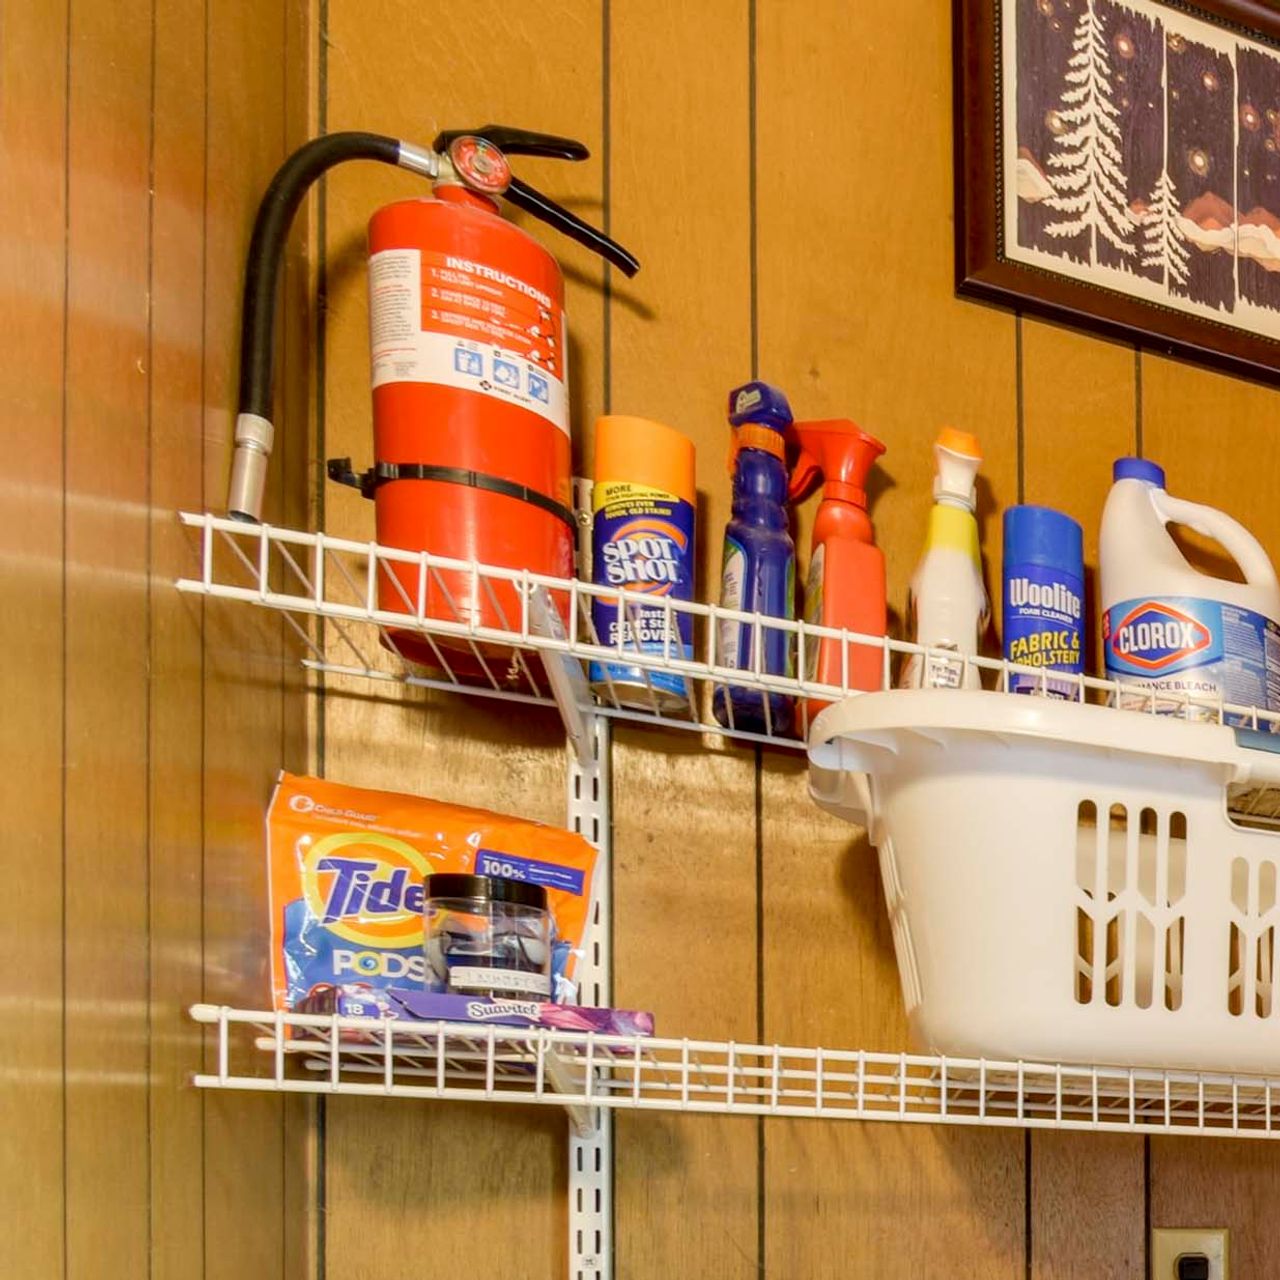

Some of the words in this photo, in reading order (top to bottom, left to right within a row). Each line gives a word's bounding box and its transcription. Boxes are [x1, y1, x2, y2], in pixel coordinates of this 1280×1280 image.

[445, 256, 552, 309] INSTRUCTIONS
[605, 484, 632, 497] MORE
[602, 538, 673, 563] SPOT
[607, 559, 679, 584] SHOT
[1010, 578, 1080, 619] Woolite
[1019, 607, 1041, 616] FOAM
[1042, 609, 1073, 624] CLEANER
[1010, 631, 1069, 660] FABRIC
[1071, 630, 1080, 649] &
[1119, 621, 1196, 654] CLOROX
[1174, 681, 1217, 692] BLEACH
[483, 860, 525, 880] 100%
[316, 857, 437, 925] Tide
[332, 949, 426, 983] PODS
[344, 1004, 364, 1015] 18
